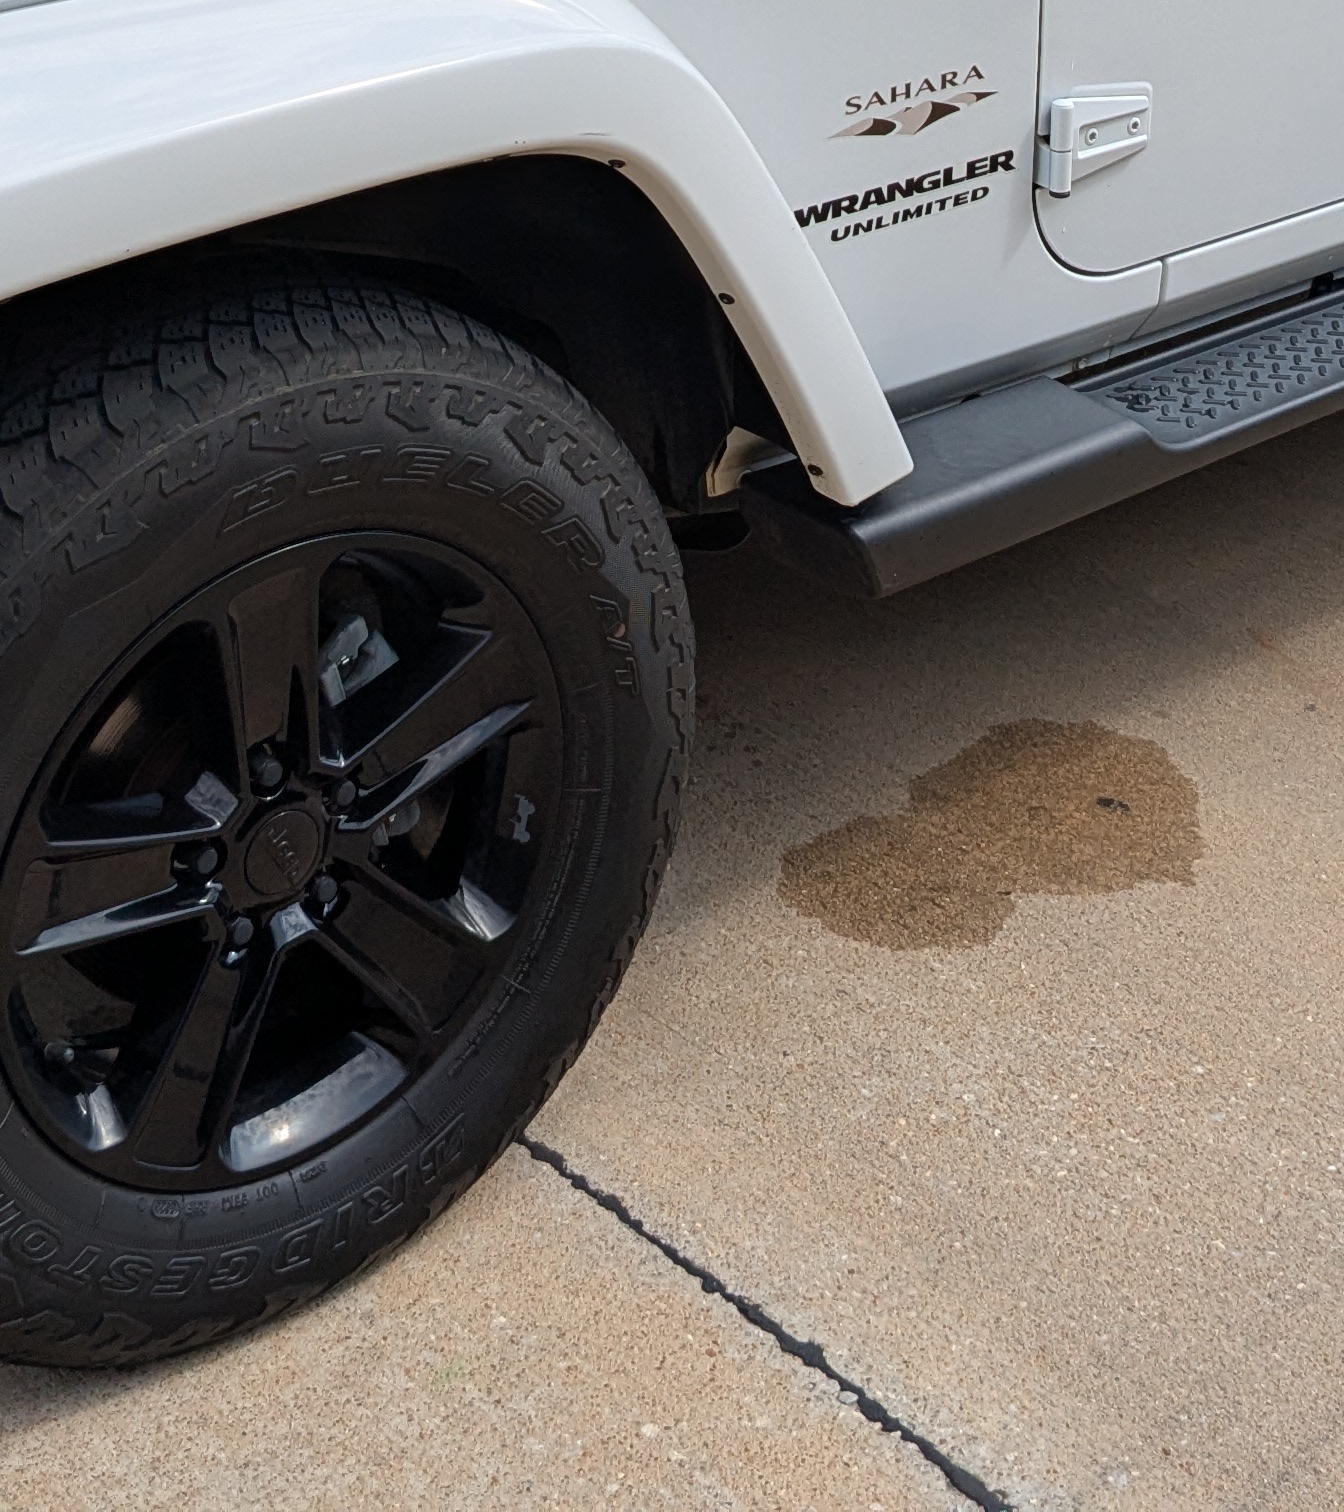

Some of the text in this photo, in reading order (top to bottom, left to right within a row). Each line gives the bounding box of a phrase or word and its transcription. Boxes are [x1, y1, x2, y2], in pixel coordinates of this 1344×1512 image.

[844, 65, 986, 116] SAHARA
[793, 149, 1017, 229] WRANGLER
[830, 185, 991, 242] UNLIMITED
[218, 441, 606, 574] DUELER
